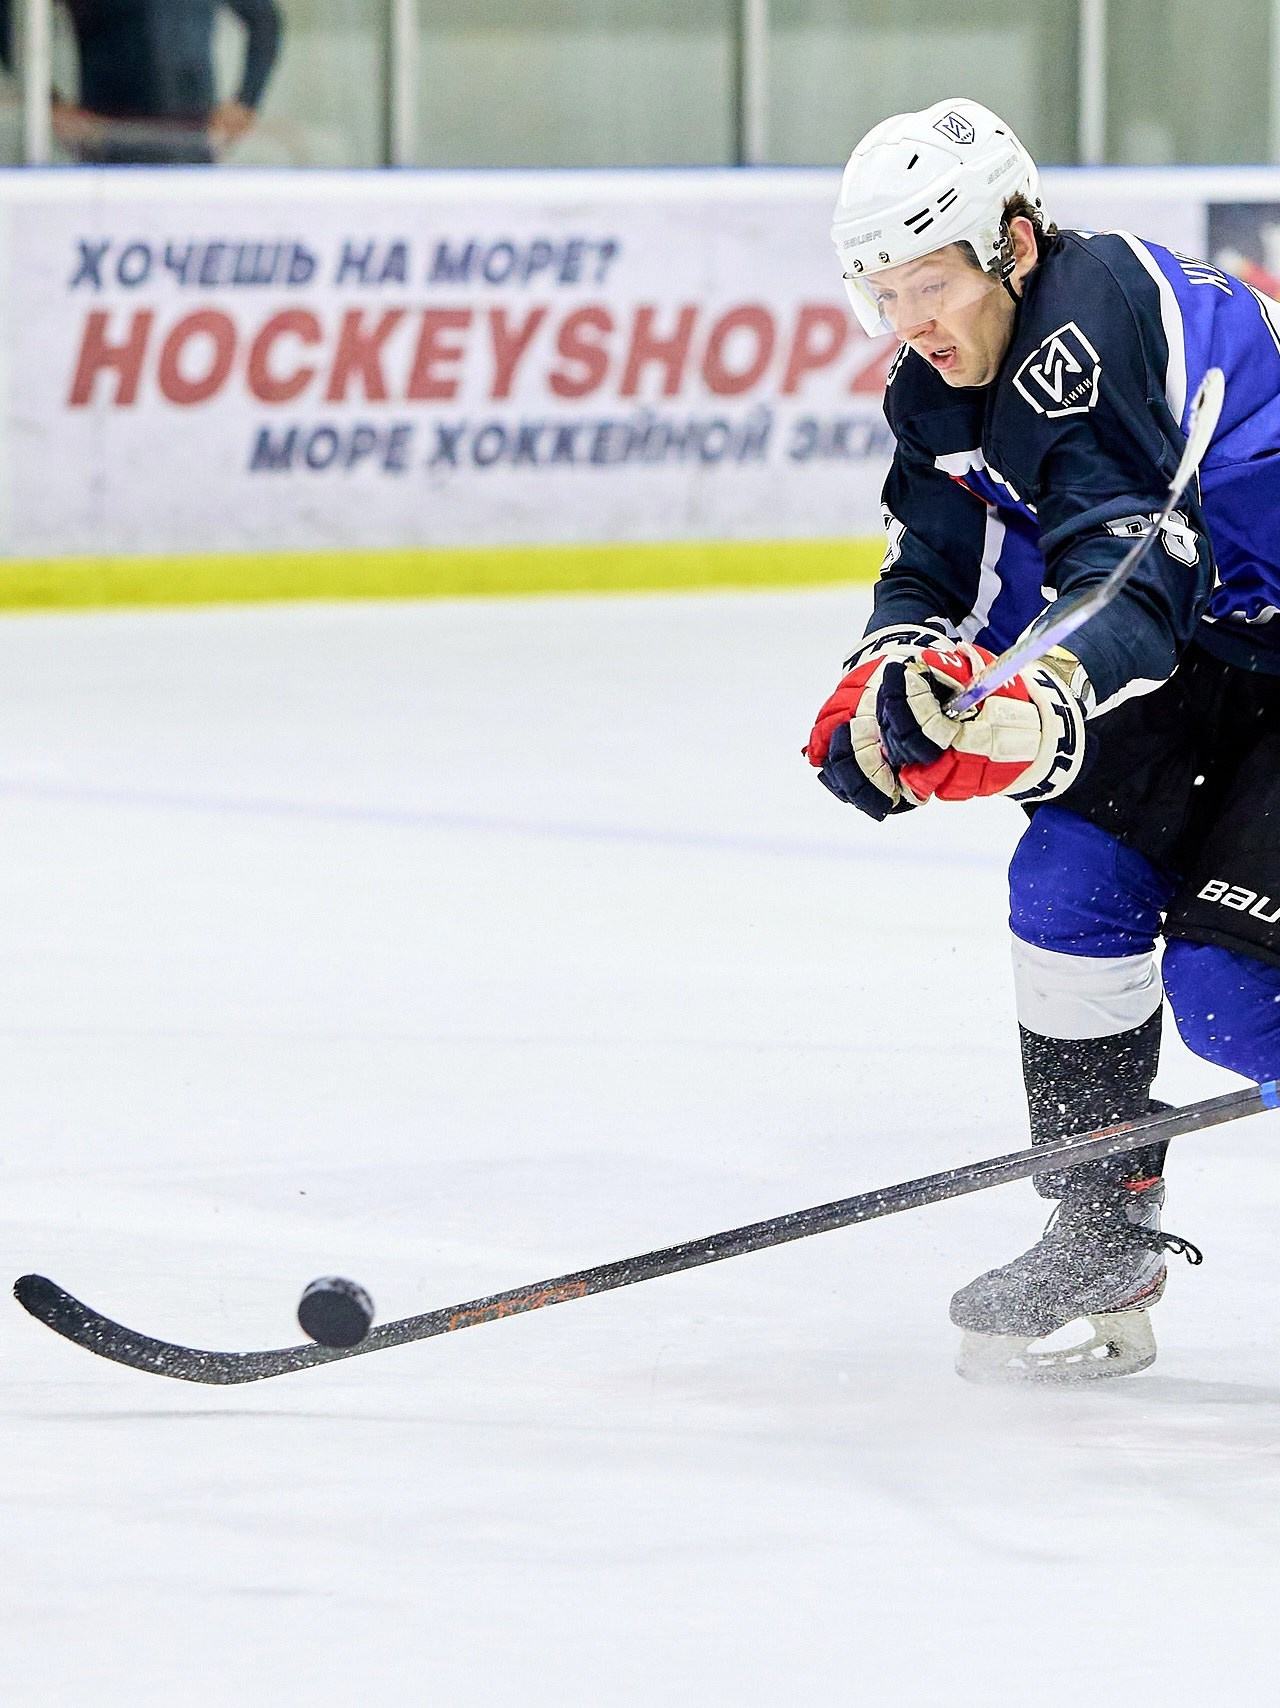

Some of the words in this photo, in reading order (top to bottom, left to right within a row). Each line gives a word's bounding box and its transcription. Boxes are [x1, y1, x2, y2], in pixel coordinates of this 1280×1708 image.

[69, 236, 316, 291] ХОЧЕШЬ
[335, 237, 409, 289] НА
[428, 235, 621, 288] МОРЕ?
[249, 421, 410, 472] МОРЕ
[428, 406, 769, 471] ХОККЕЙНОЙ
